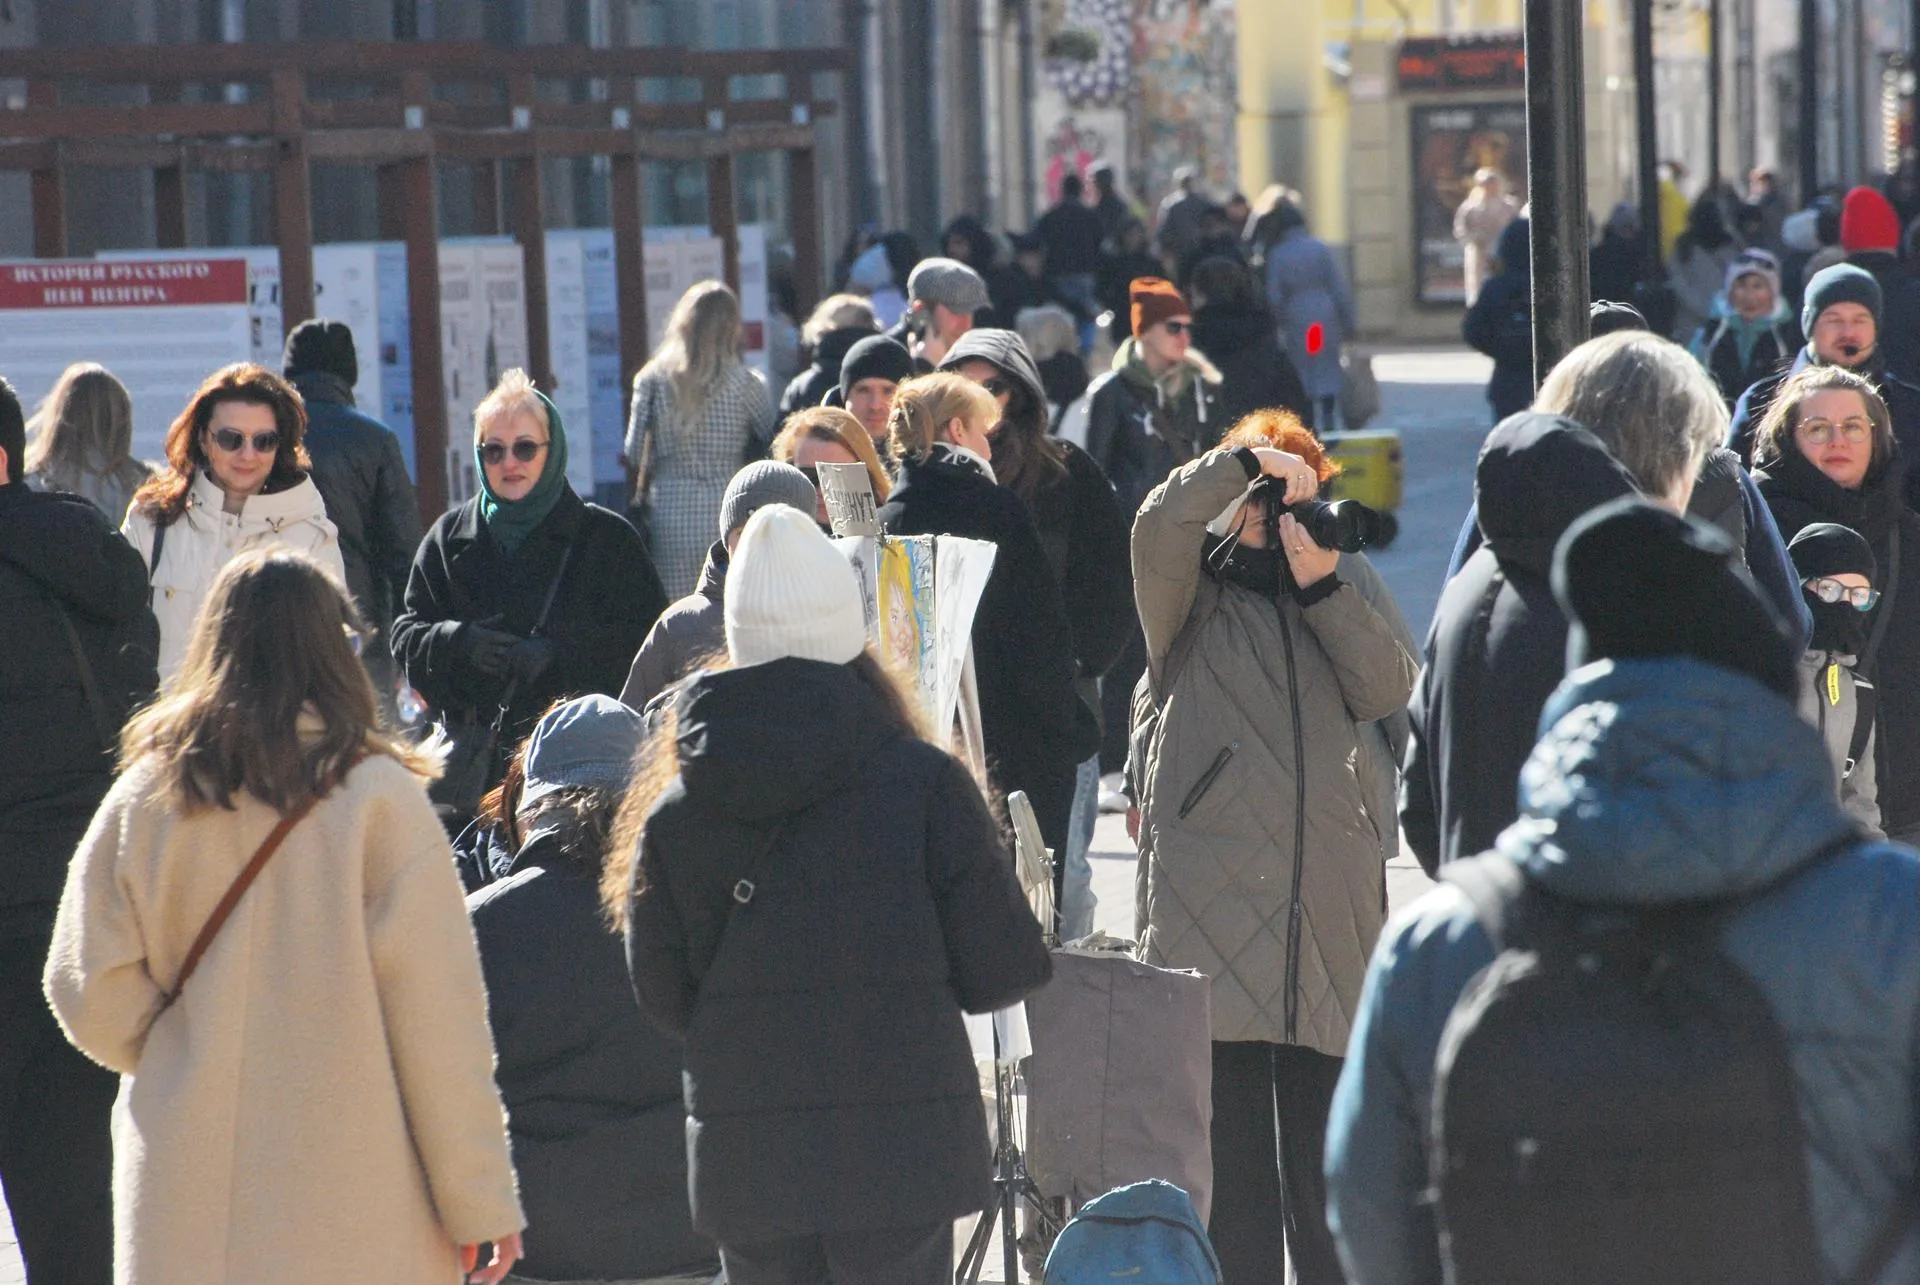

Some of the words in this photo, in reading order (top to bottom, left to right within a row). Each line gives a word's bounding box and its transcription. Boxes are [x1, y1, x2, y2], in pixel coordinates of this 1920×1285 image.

[14, 265, 105, 283] ИСТОРИЯ
[110, 262, 209, 280] РУССКОГО
[91, 286, 167, 303] ЦЕНТРА
